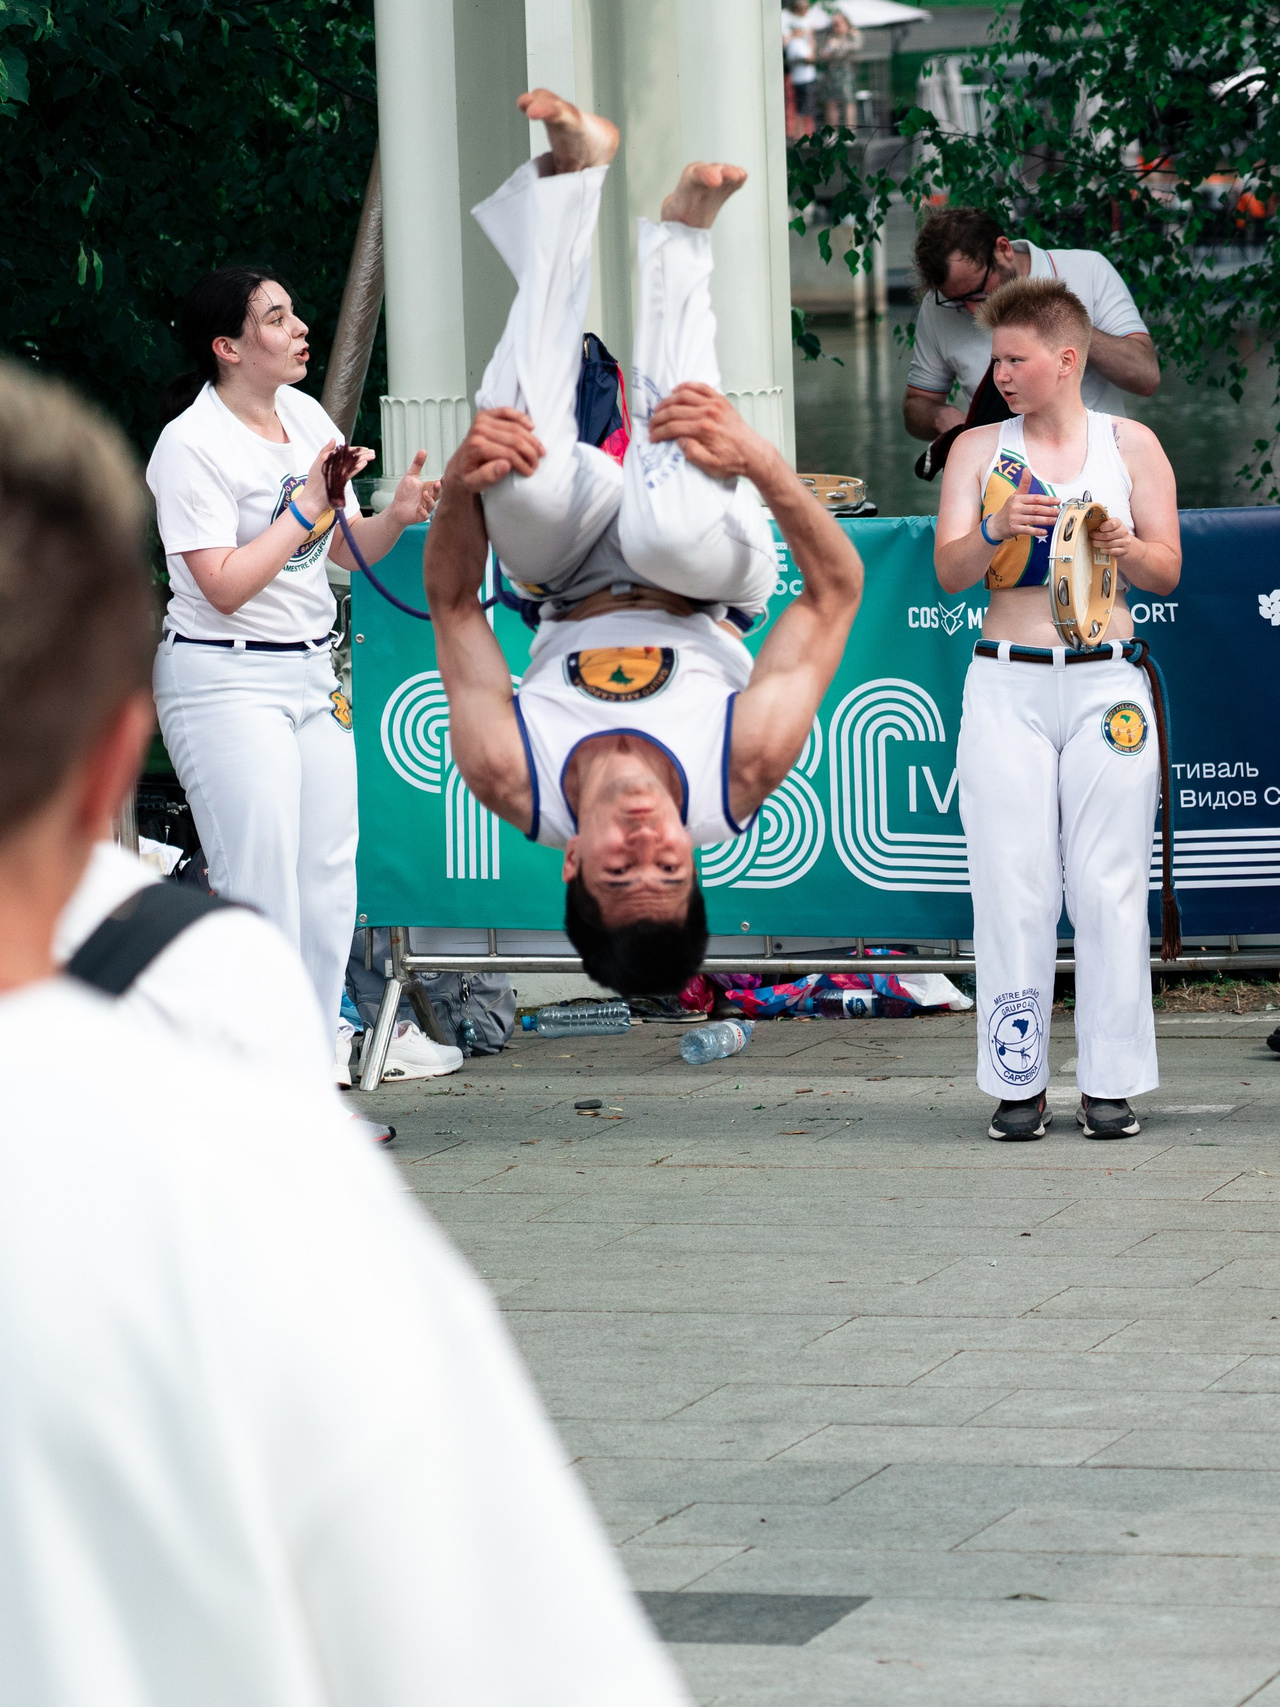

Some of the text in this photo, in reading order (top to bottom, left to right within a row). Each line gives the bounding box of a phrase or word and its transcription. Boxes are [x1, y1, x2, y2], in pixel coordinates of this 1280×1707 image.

[1130, 602, 1179, 624] ORT
[1171, 762, 1259, 780] тиваль
[1180, 786, 1257, 810] Видов
[993, 991, 1020, 1006] MESTRE
[1001, 1001, 1027, 1016] GRUPO
[1003, 1066, 1038, 1082] CAPOEIRA
